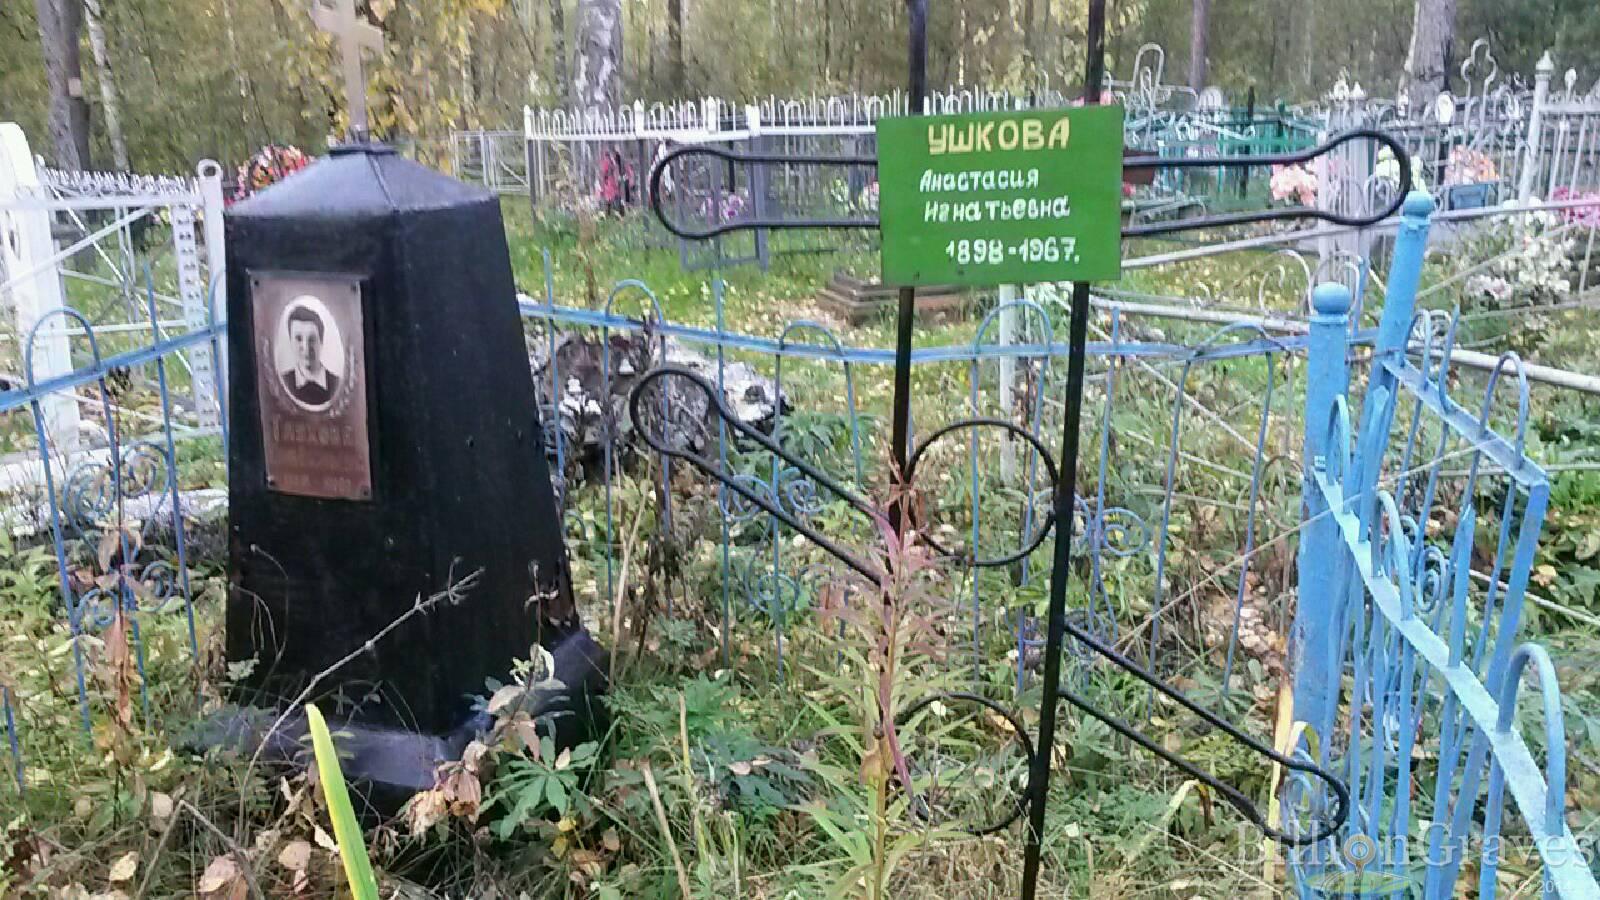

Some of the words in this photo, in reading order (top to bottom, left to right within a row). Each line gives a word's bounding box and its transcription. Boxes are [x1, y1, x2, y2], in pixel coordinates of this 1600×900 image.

[928, 117, 1070, 155] УШКОВА
[919, 168, 1039, 193] Анастасия
[924, 195, 1071, 222] Игнатьевна
